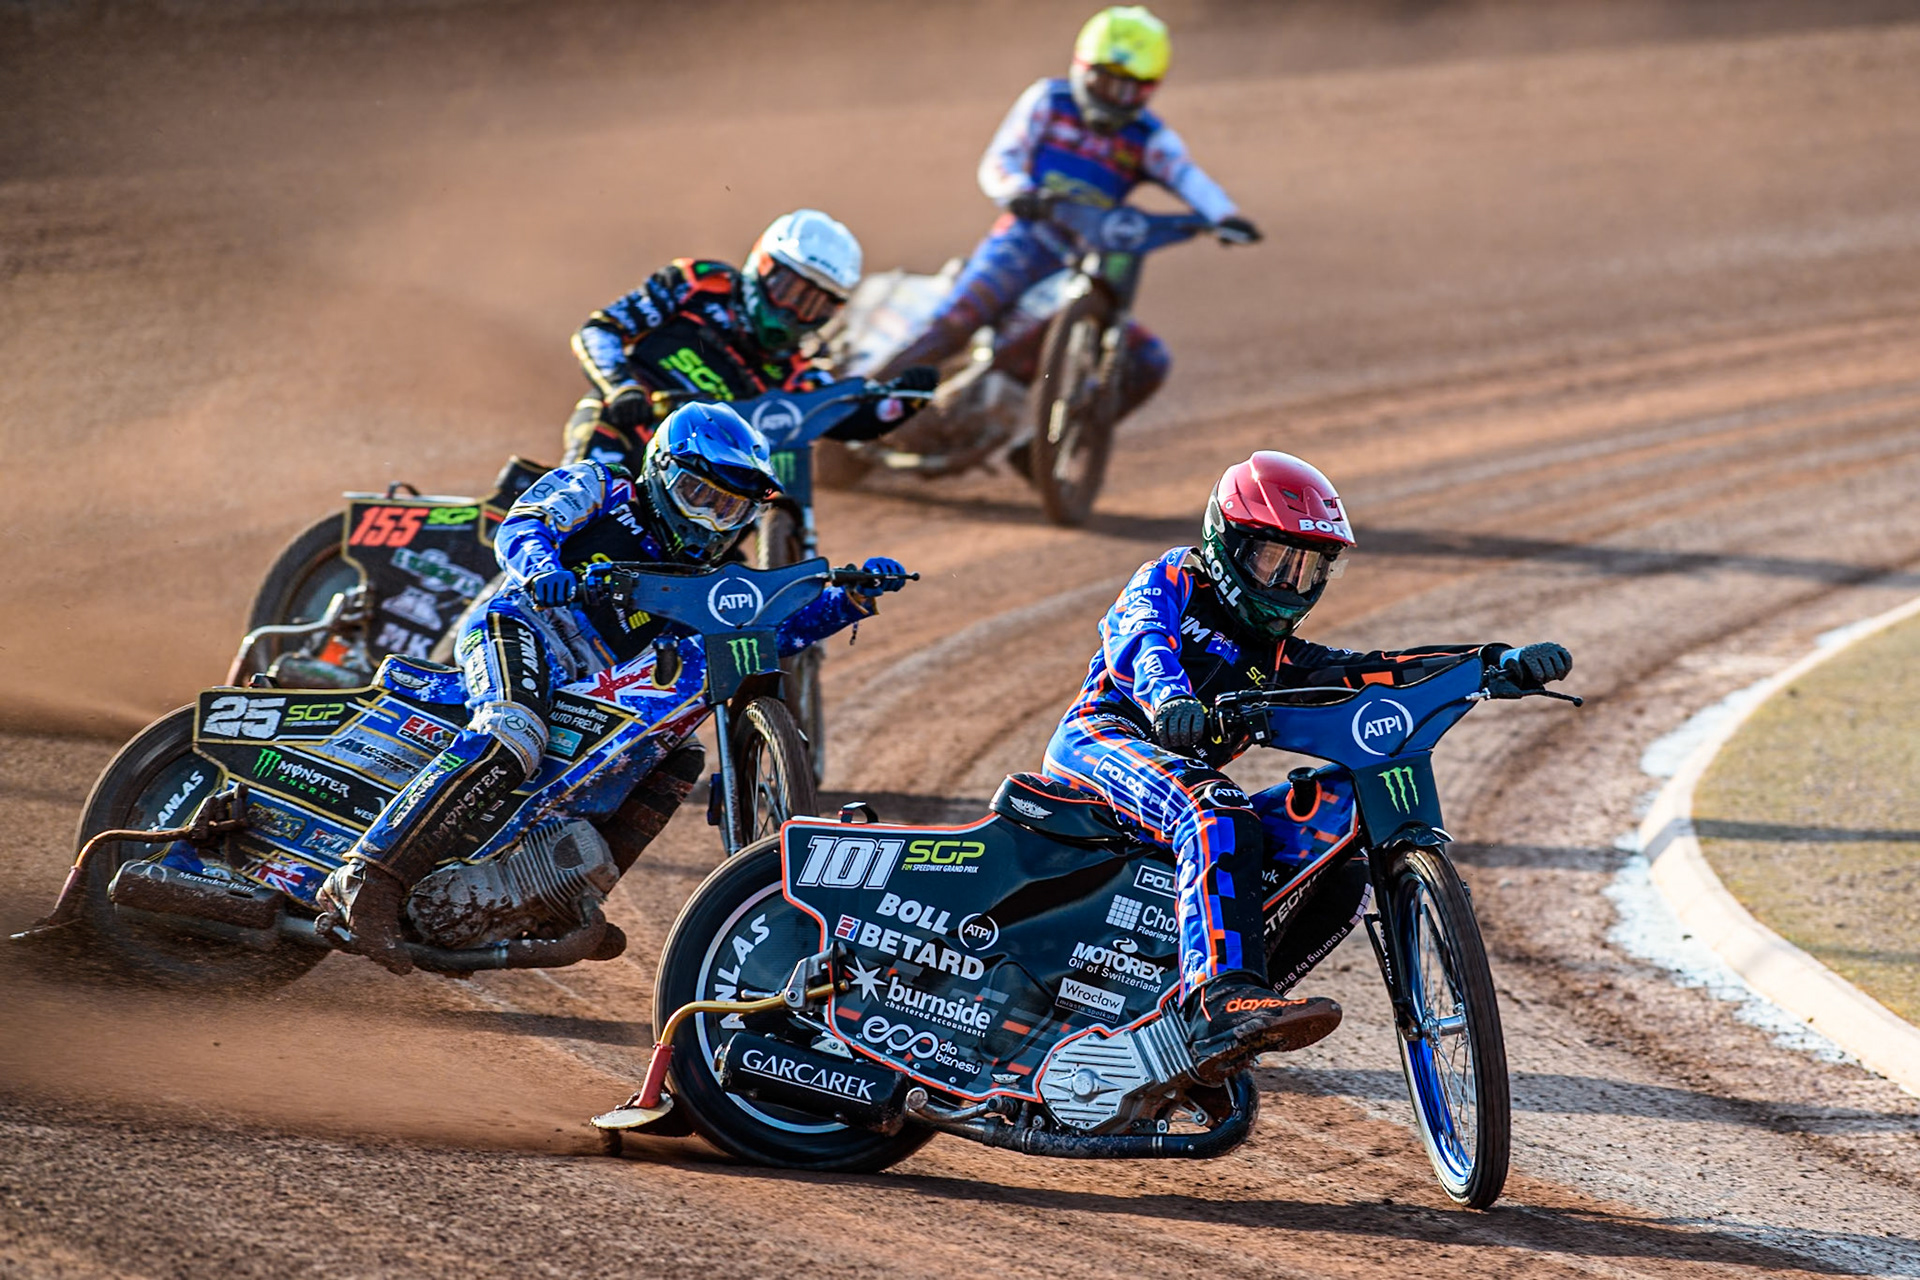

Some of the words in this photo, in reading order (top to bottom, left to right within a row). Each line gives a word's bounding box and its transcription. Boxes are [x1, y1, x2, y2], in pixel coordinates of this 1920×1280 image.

[349, 506, 430, 547] 155
[609, 503, 644, 535] FIM
[717, 594, 754, 611] ATPI
[202, 695, 287, 739] 25
[284, 703, 345, 721] SGP
[402, 716, 443, 741] EK
[1363, 715, 1402, 739] ATPI
[278, 775, 339, 804] ENERGY
[796, 835, 906, 889] 101
[904, 840, 986, 865] SGP
[912, 864, 943, 872] SPEEDWAY
[943, 865, 963, 873] GRAND
[876, 892, 952, 934] BOLL
[964, 923, 993, 940] ATPI
[1137, 925, 1168, 942] Flooring
[1306, 926, 1348, 963] Flooring
[858, 922, 985, 980] BETARD
[1071, 941, 1165, 984] MOTOREX
[1068, 957, 1084, 969] Oil
[1086, 965, 1099, 974] of
[1101, 967, 1161, 993] Switzerland
[1295, 961, 1309, 974] by
[887, 976, 991, 1030] burnside
[1066, 981, 1121, 1009] Wrocław
[884, 1000, 930, 1020] chartered
[931, 1016, 986, 1038] accountants
[939, 1040, 958, 1056] dla
[742, 1049, 877, 1100] GARCAREK
[934, 1053, 983, 1075] biznesu
